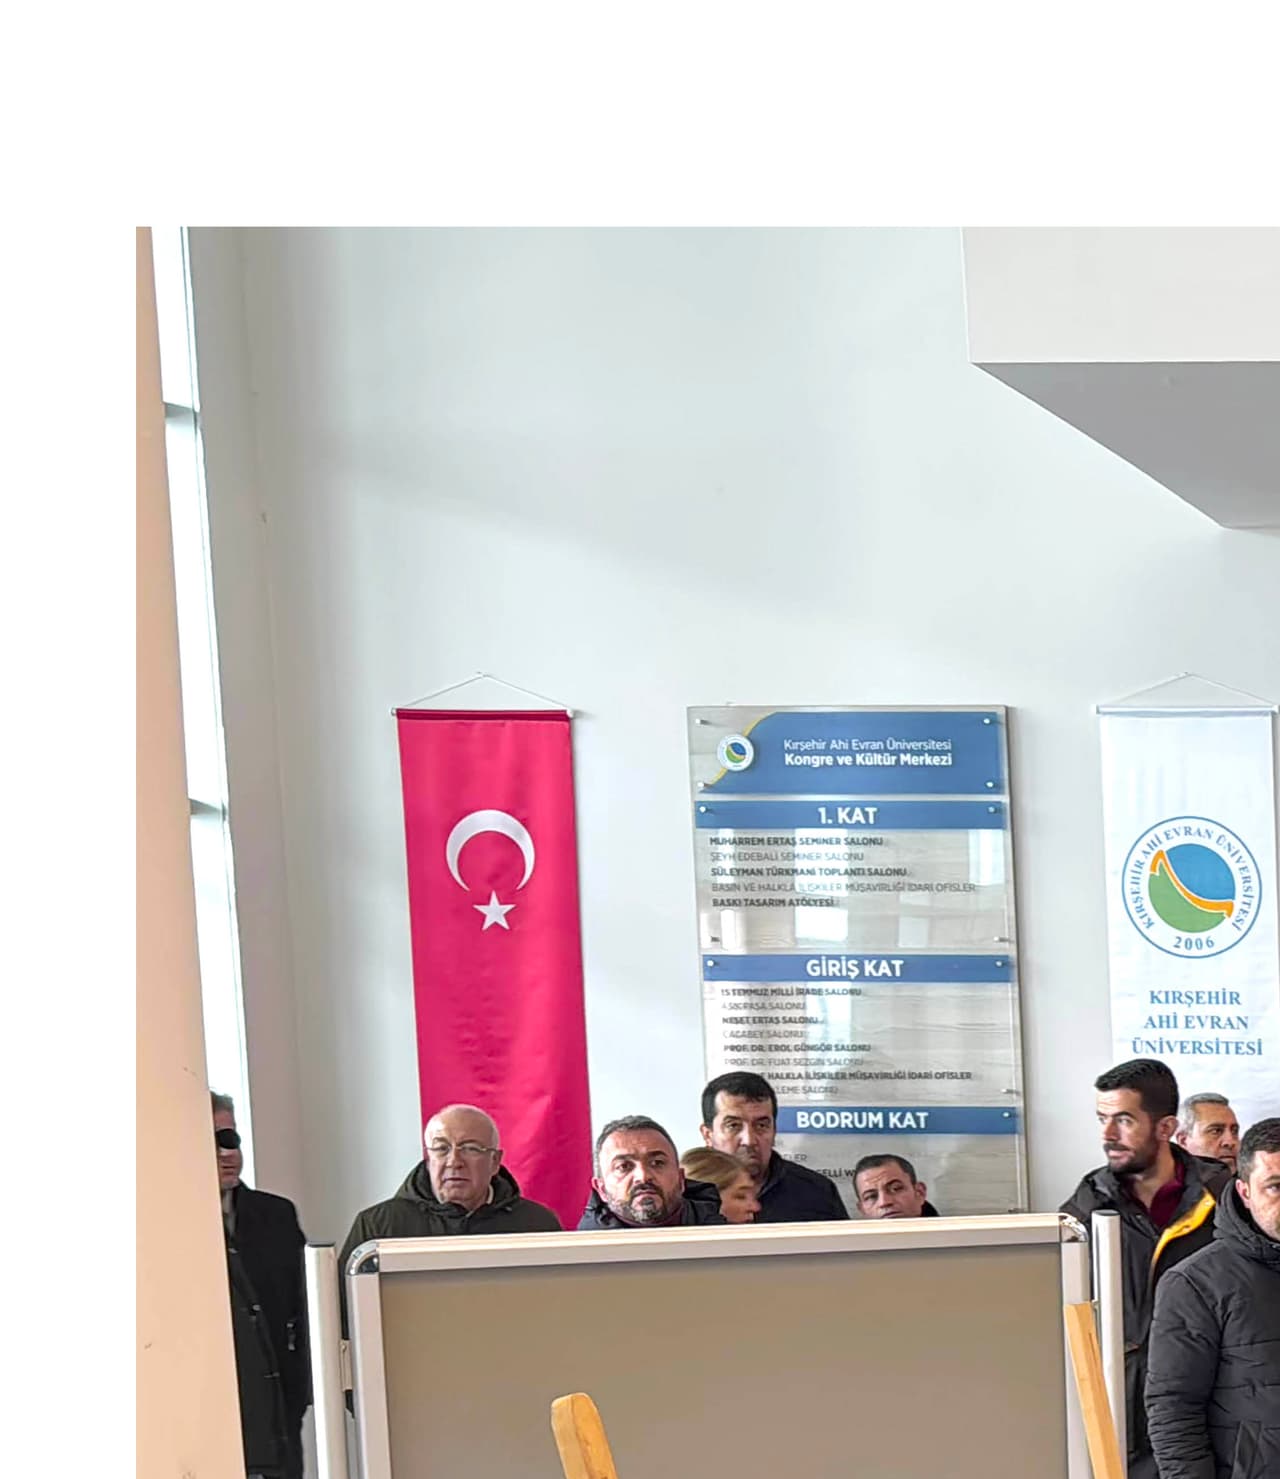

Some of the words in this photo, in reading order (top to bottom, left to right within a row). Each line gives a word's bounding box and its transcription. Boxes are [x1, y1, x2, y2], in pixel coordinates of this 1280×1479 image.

[784, 739, 827, 752] Kırşehir
[830, 739, 849, 750] Ahi
[851, 739, 884, 750] Evran
[887, 737, 952, 750] Üniversitesi
[784, 753, 833, 767] Kongre
[836, 755, 853, 766] ve
[855, 753, 897, 766] Kültür
[900, 753, 953, 766] Merkezi
[817, 806, 833, 825] 1.
[837, 806, 878, 825] KAT
[1163, 825, 1215, 841] EVRAN
[709, 836, 765, 846] MUHARREM
[843, 837, 884, 846] SALONU
[824, 852, 864, 861] SALONU
[711, 865, 764, 877] SÜLEYMAN
[818, 867, 865, 877] TOPLANTI
[867, 868, 907, 877] SALONU
[743, 882, 757, 892] VE
[744, 898, 786, 908] TASARIM
[1173, 935, 1216, 951] 2006
[806, 955, 860, 979] GİRİŞ
[864, 959, 904, 977] KAT
[824, 987, 862, 996] SALONU
[1149, 987, 1242, 1008] KIRŞEHİR
[781, 1015, 818, 1024] SALONU
[1143, 1012, 1179, 1029] AHİ
[1184, 1015, 1249, 1030] EVRAN
[768, 1044, 792, 1052] EROL
[1131, 1036, 1263, 1056] ÜNİVERSİTESİ
[796, 1111, 884, 1129] BODRUM
[888, 1111, 929, 1129] KAT
